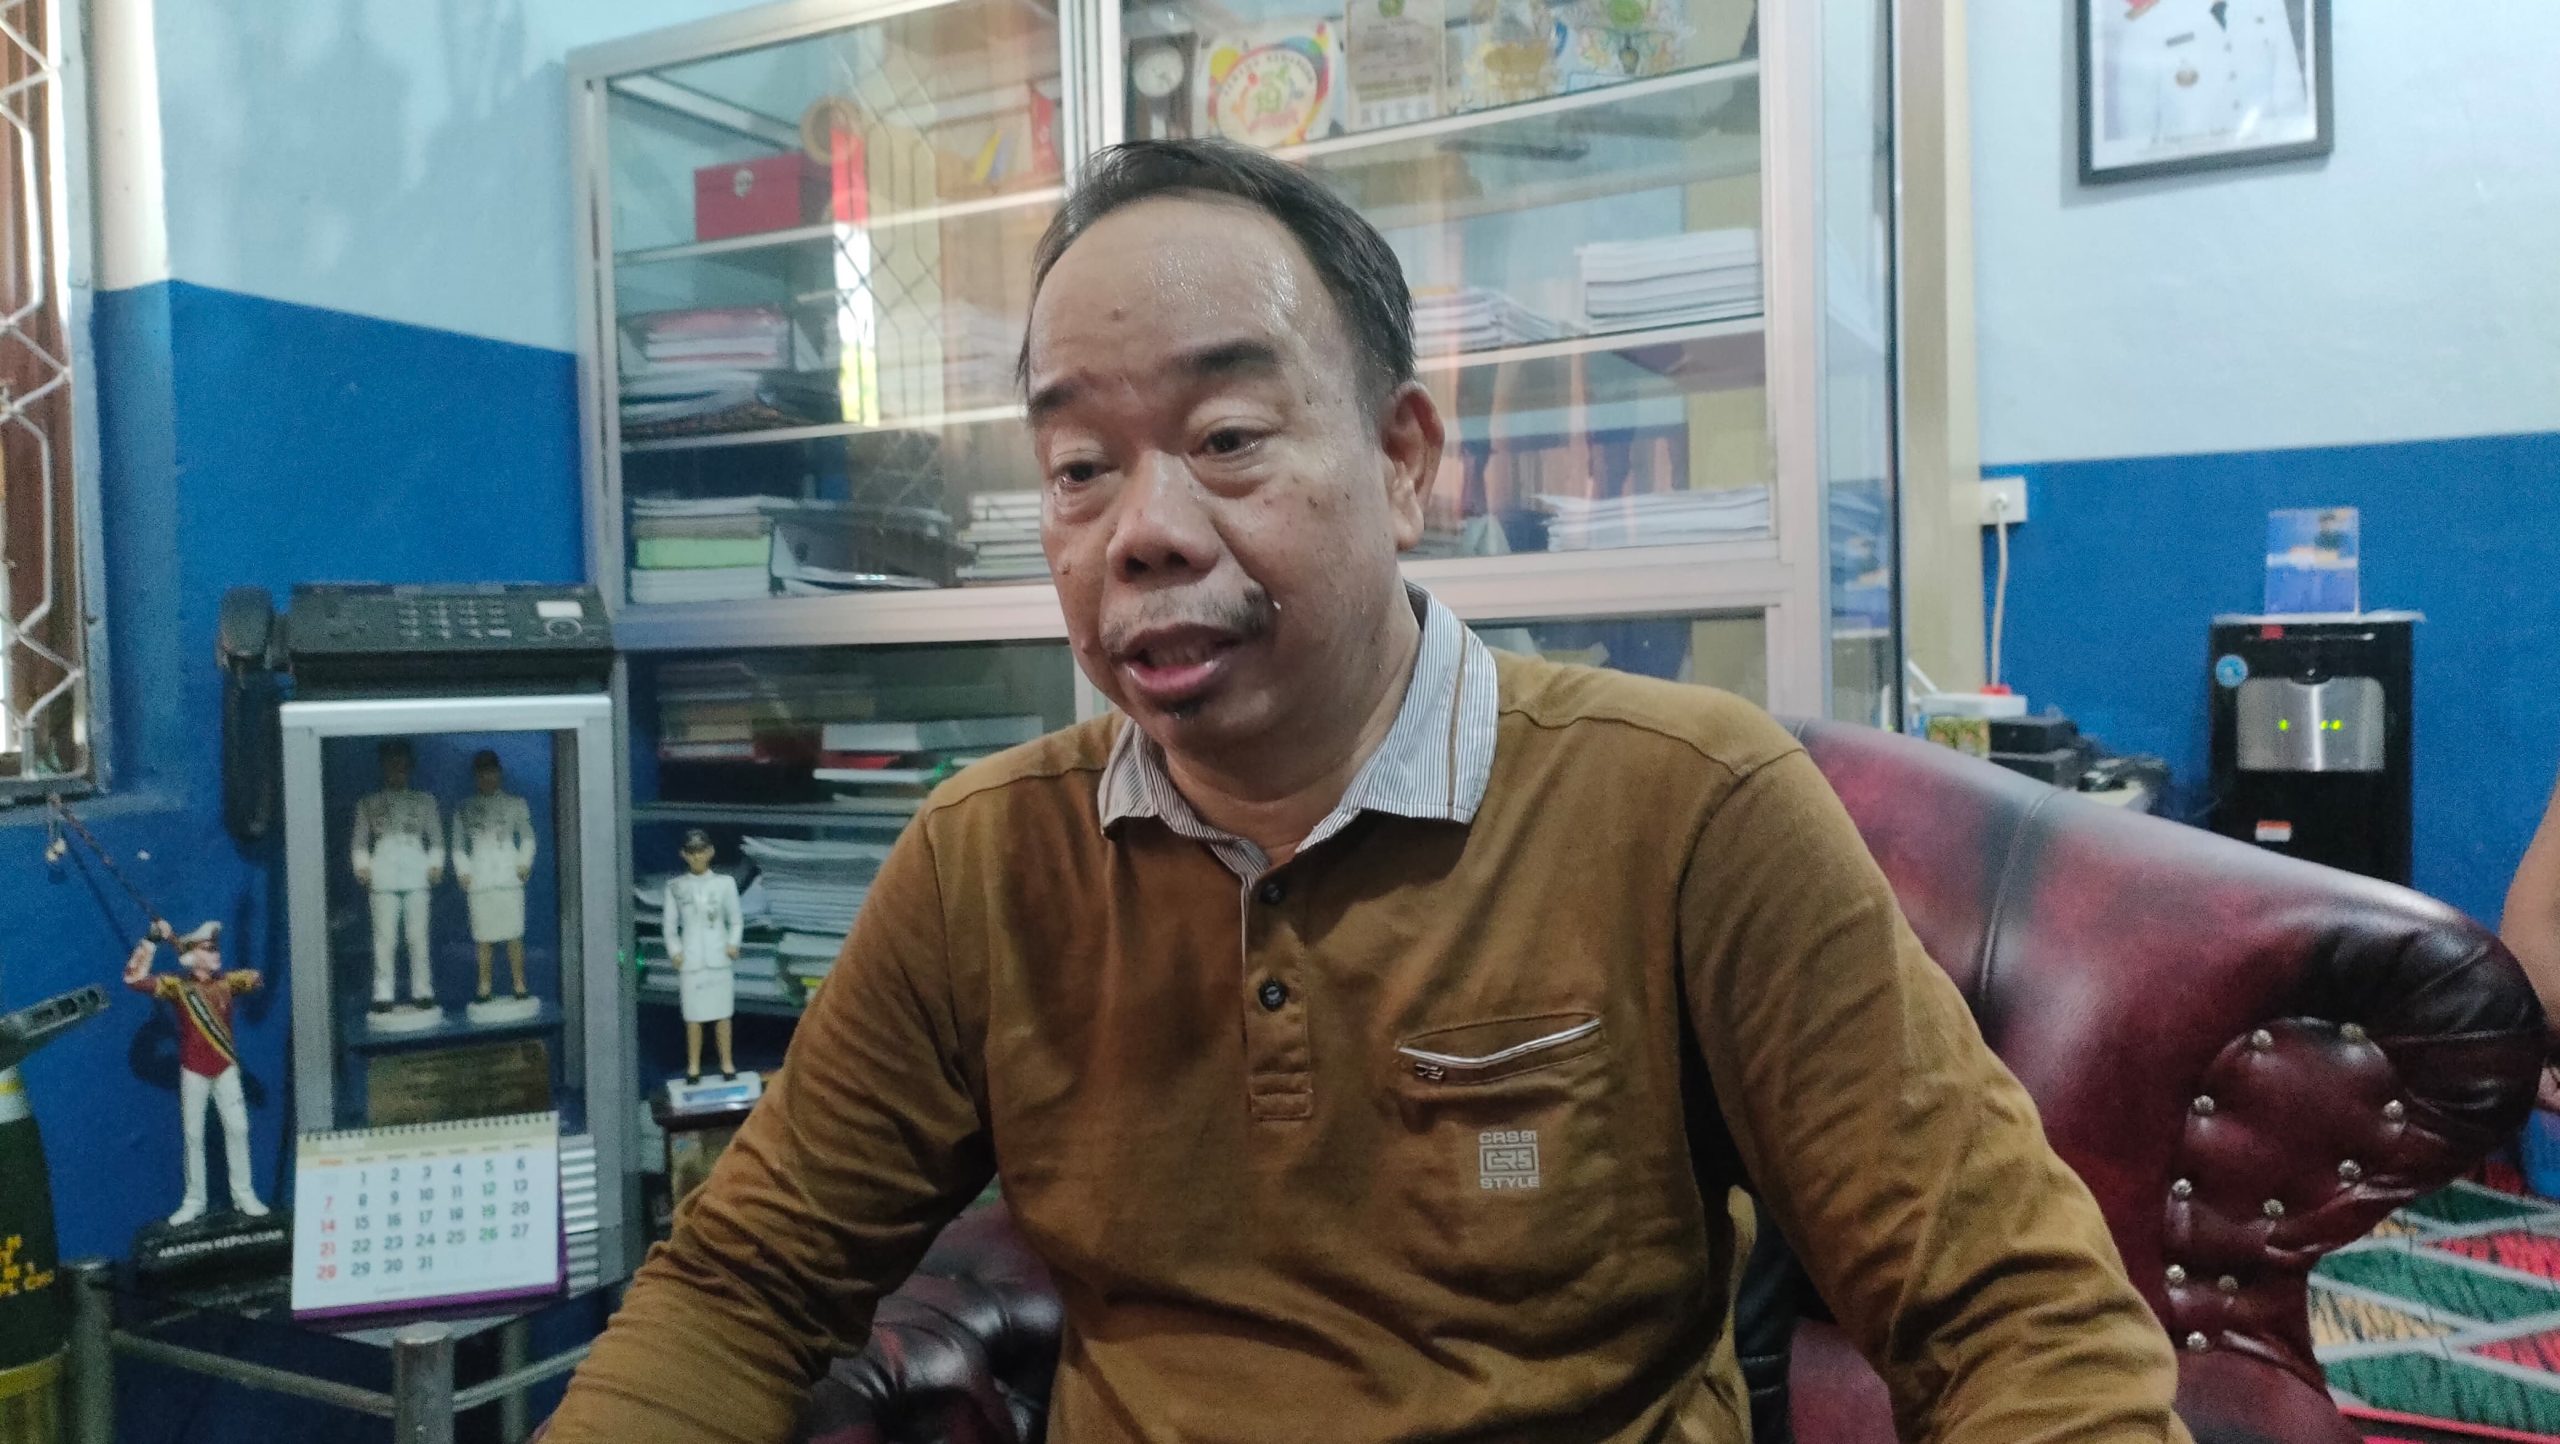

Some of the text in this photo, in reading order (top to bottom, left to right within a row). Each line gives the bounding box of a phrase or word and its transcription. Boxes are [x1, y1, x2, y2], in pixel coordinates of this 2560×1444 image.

[390, 1167, 400, 1182] 2
[452, 1163, 462, 1176] 4
[484, 1159, 494, 1174] 5
[516, 1157, 526, 1171] 6
[1480, 1177, 1539, 1190] STYLE
[357, 1193, 368, 1208] 8
[389, 1190, 400, 1205] 9
[420, 1188, 434, 1201] 10
[452, 1185, 462, 1199] 11
[321, 1201, 530, 1232] 14 15 16 17 18 19 20
[352, 1238, 371, 1254] 22
[416, 1233, 435, 1247] 24
[446, 1229, 466, 1244] 25
[479, 1227, 498, 1242] 26
[511, 1223, 529, 1239] 27
[317, 1264, 337, 1280] 28
[351, 1262, 370, 1276] 29
